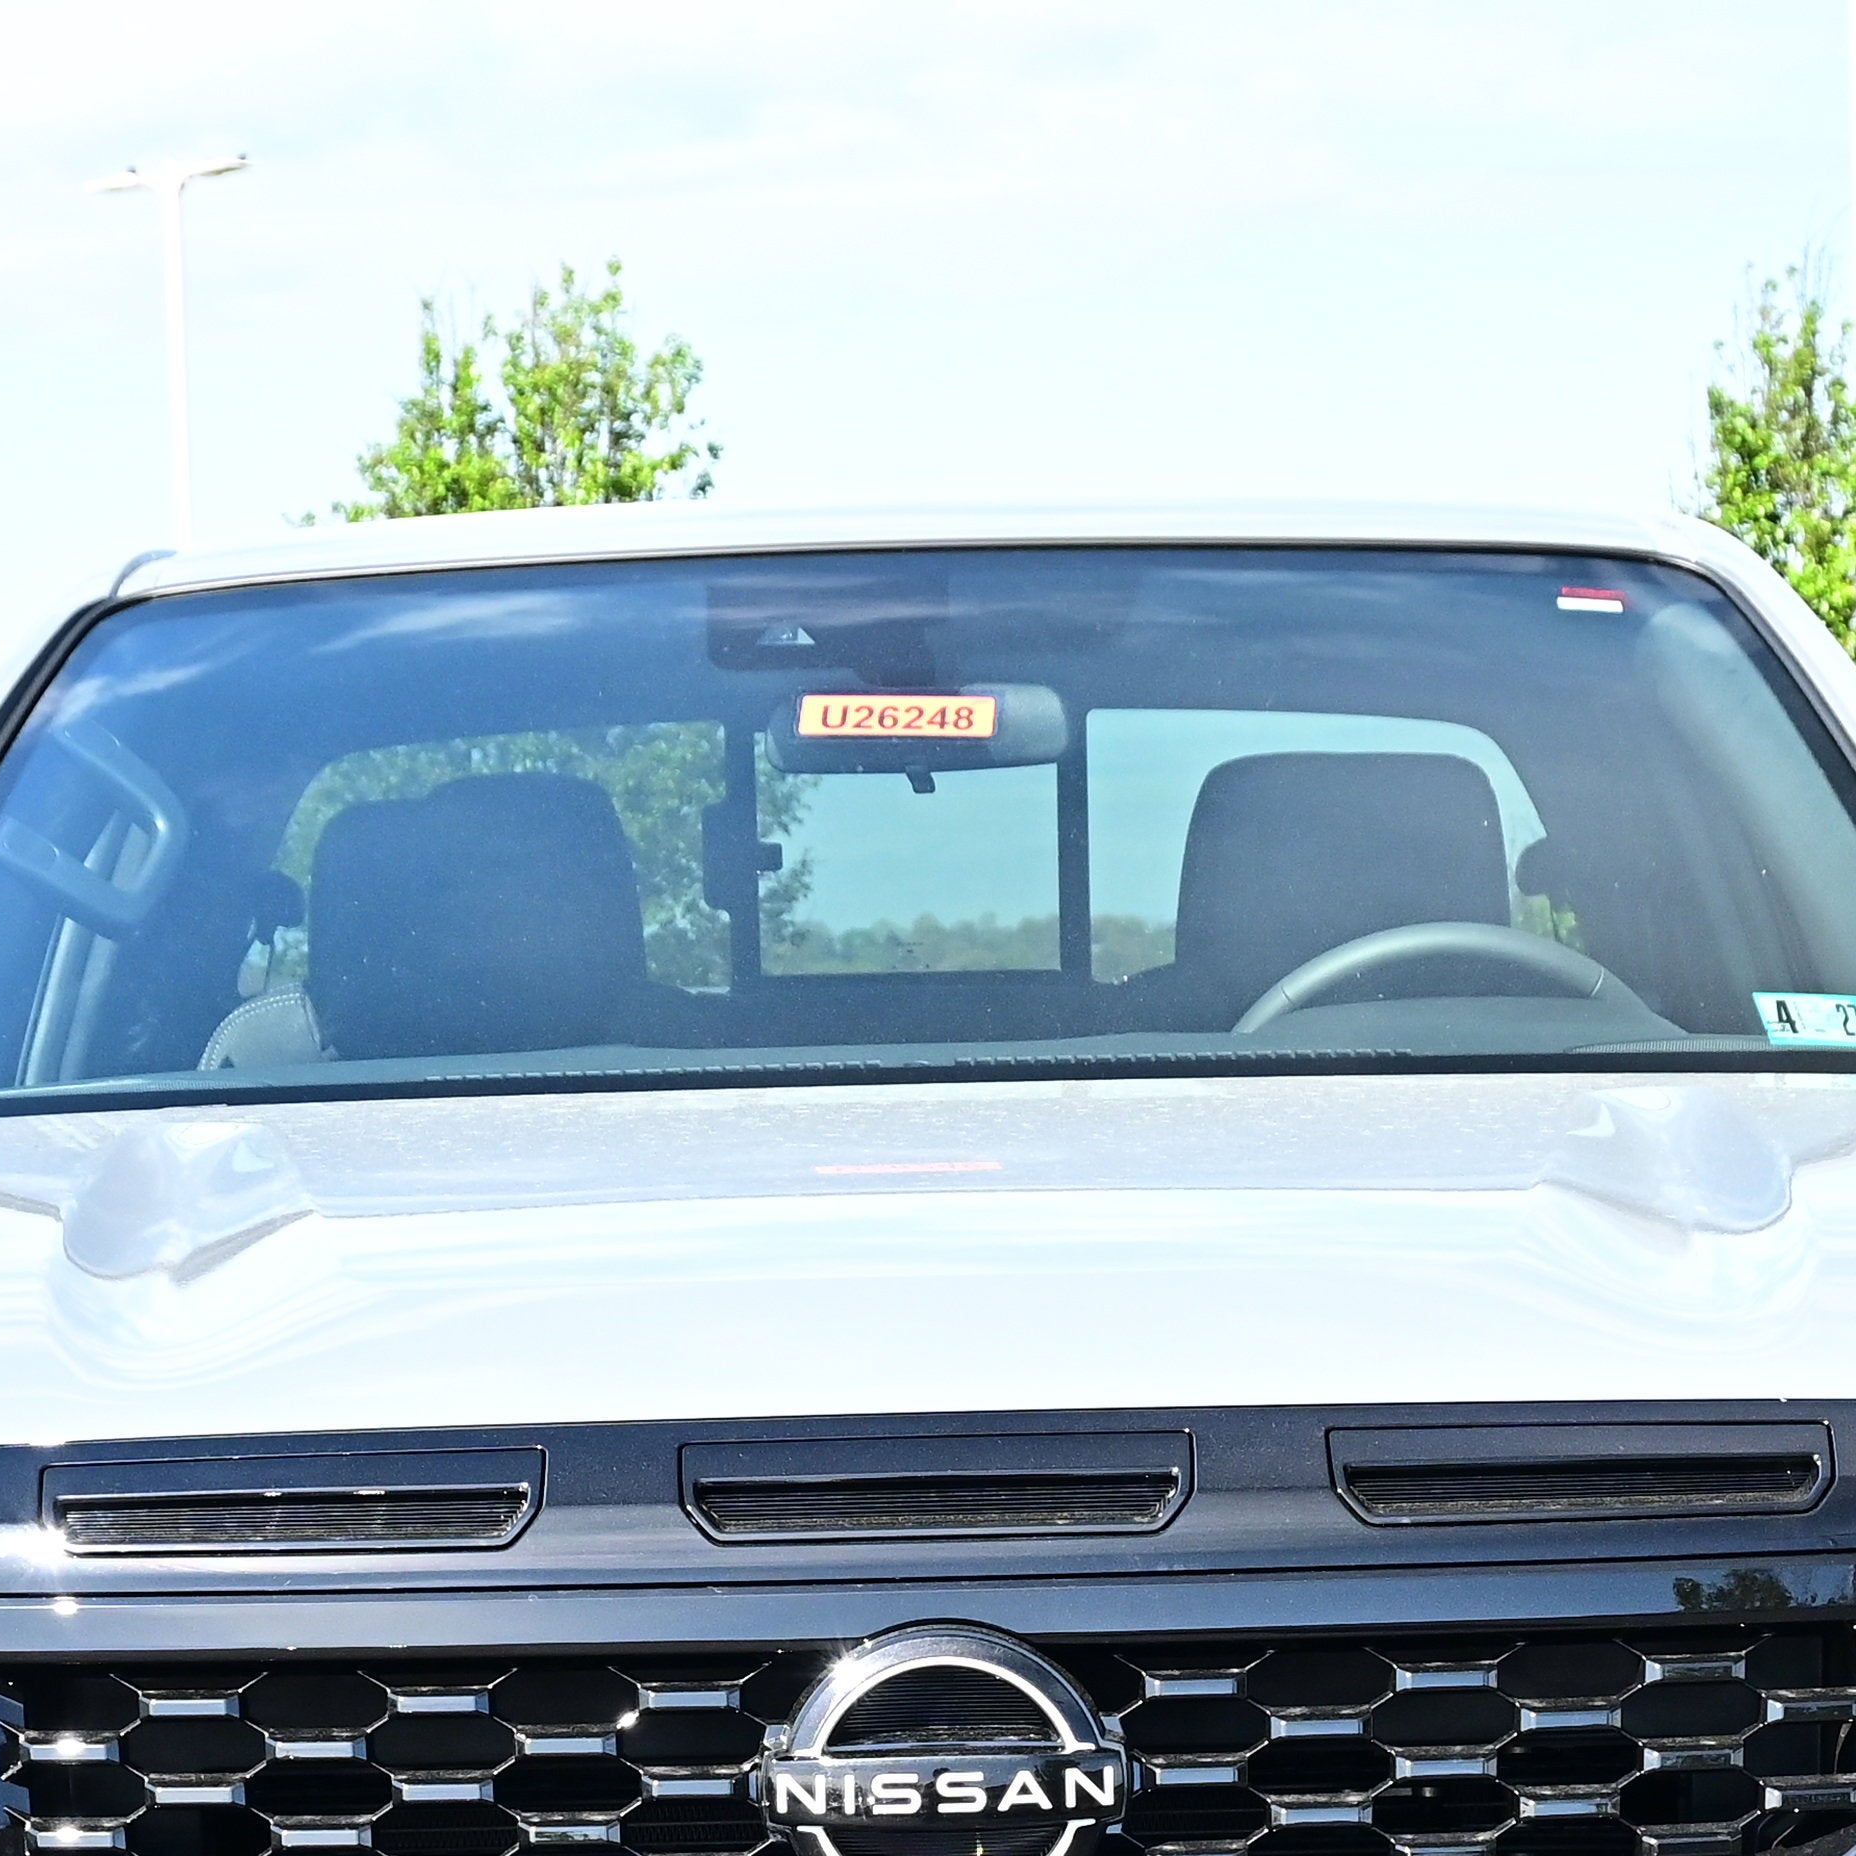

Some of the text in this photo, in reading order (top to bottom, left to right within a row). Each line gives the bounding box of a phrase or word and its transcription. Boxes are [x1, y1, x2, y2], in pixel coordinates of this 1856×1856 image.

[821, 704, 975, 731] U26248
[1775, 999, 1799, 1034] 4
[774, 1765, 1116, 1817] NISSAN
